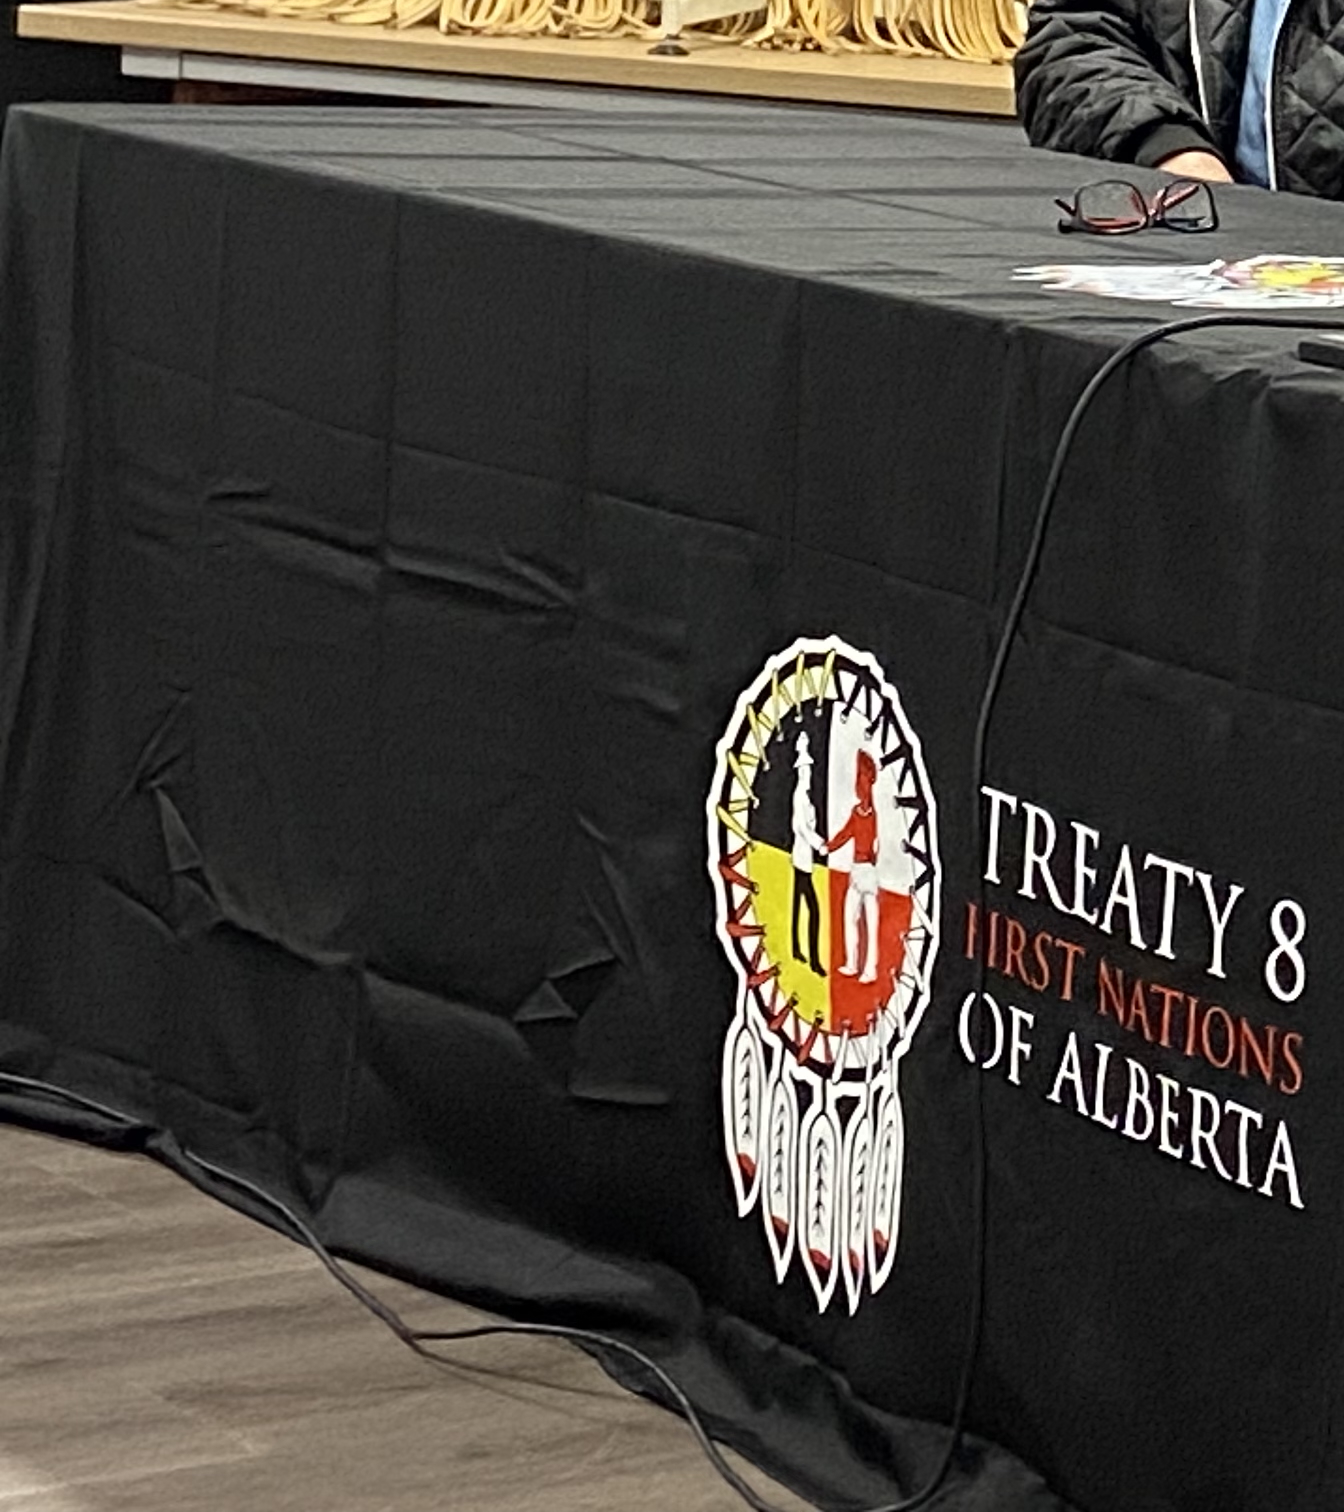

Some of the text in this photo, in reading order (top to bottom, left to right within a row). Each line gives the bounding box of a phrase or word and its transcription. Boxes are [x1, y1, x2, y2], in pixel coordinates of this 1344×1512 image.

[963, 902, 1303, 1095] FIRST NATIONS
[981, 785, 1306, 1002] TREATY 8
[959, 991, 1304, 1209] OF ALBERTA
